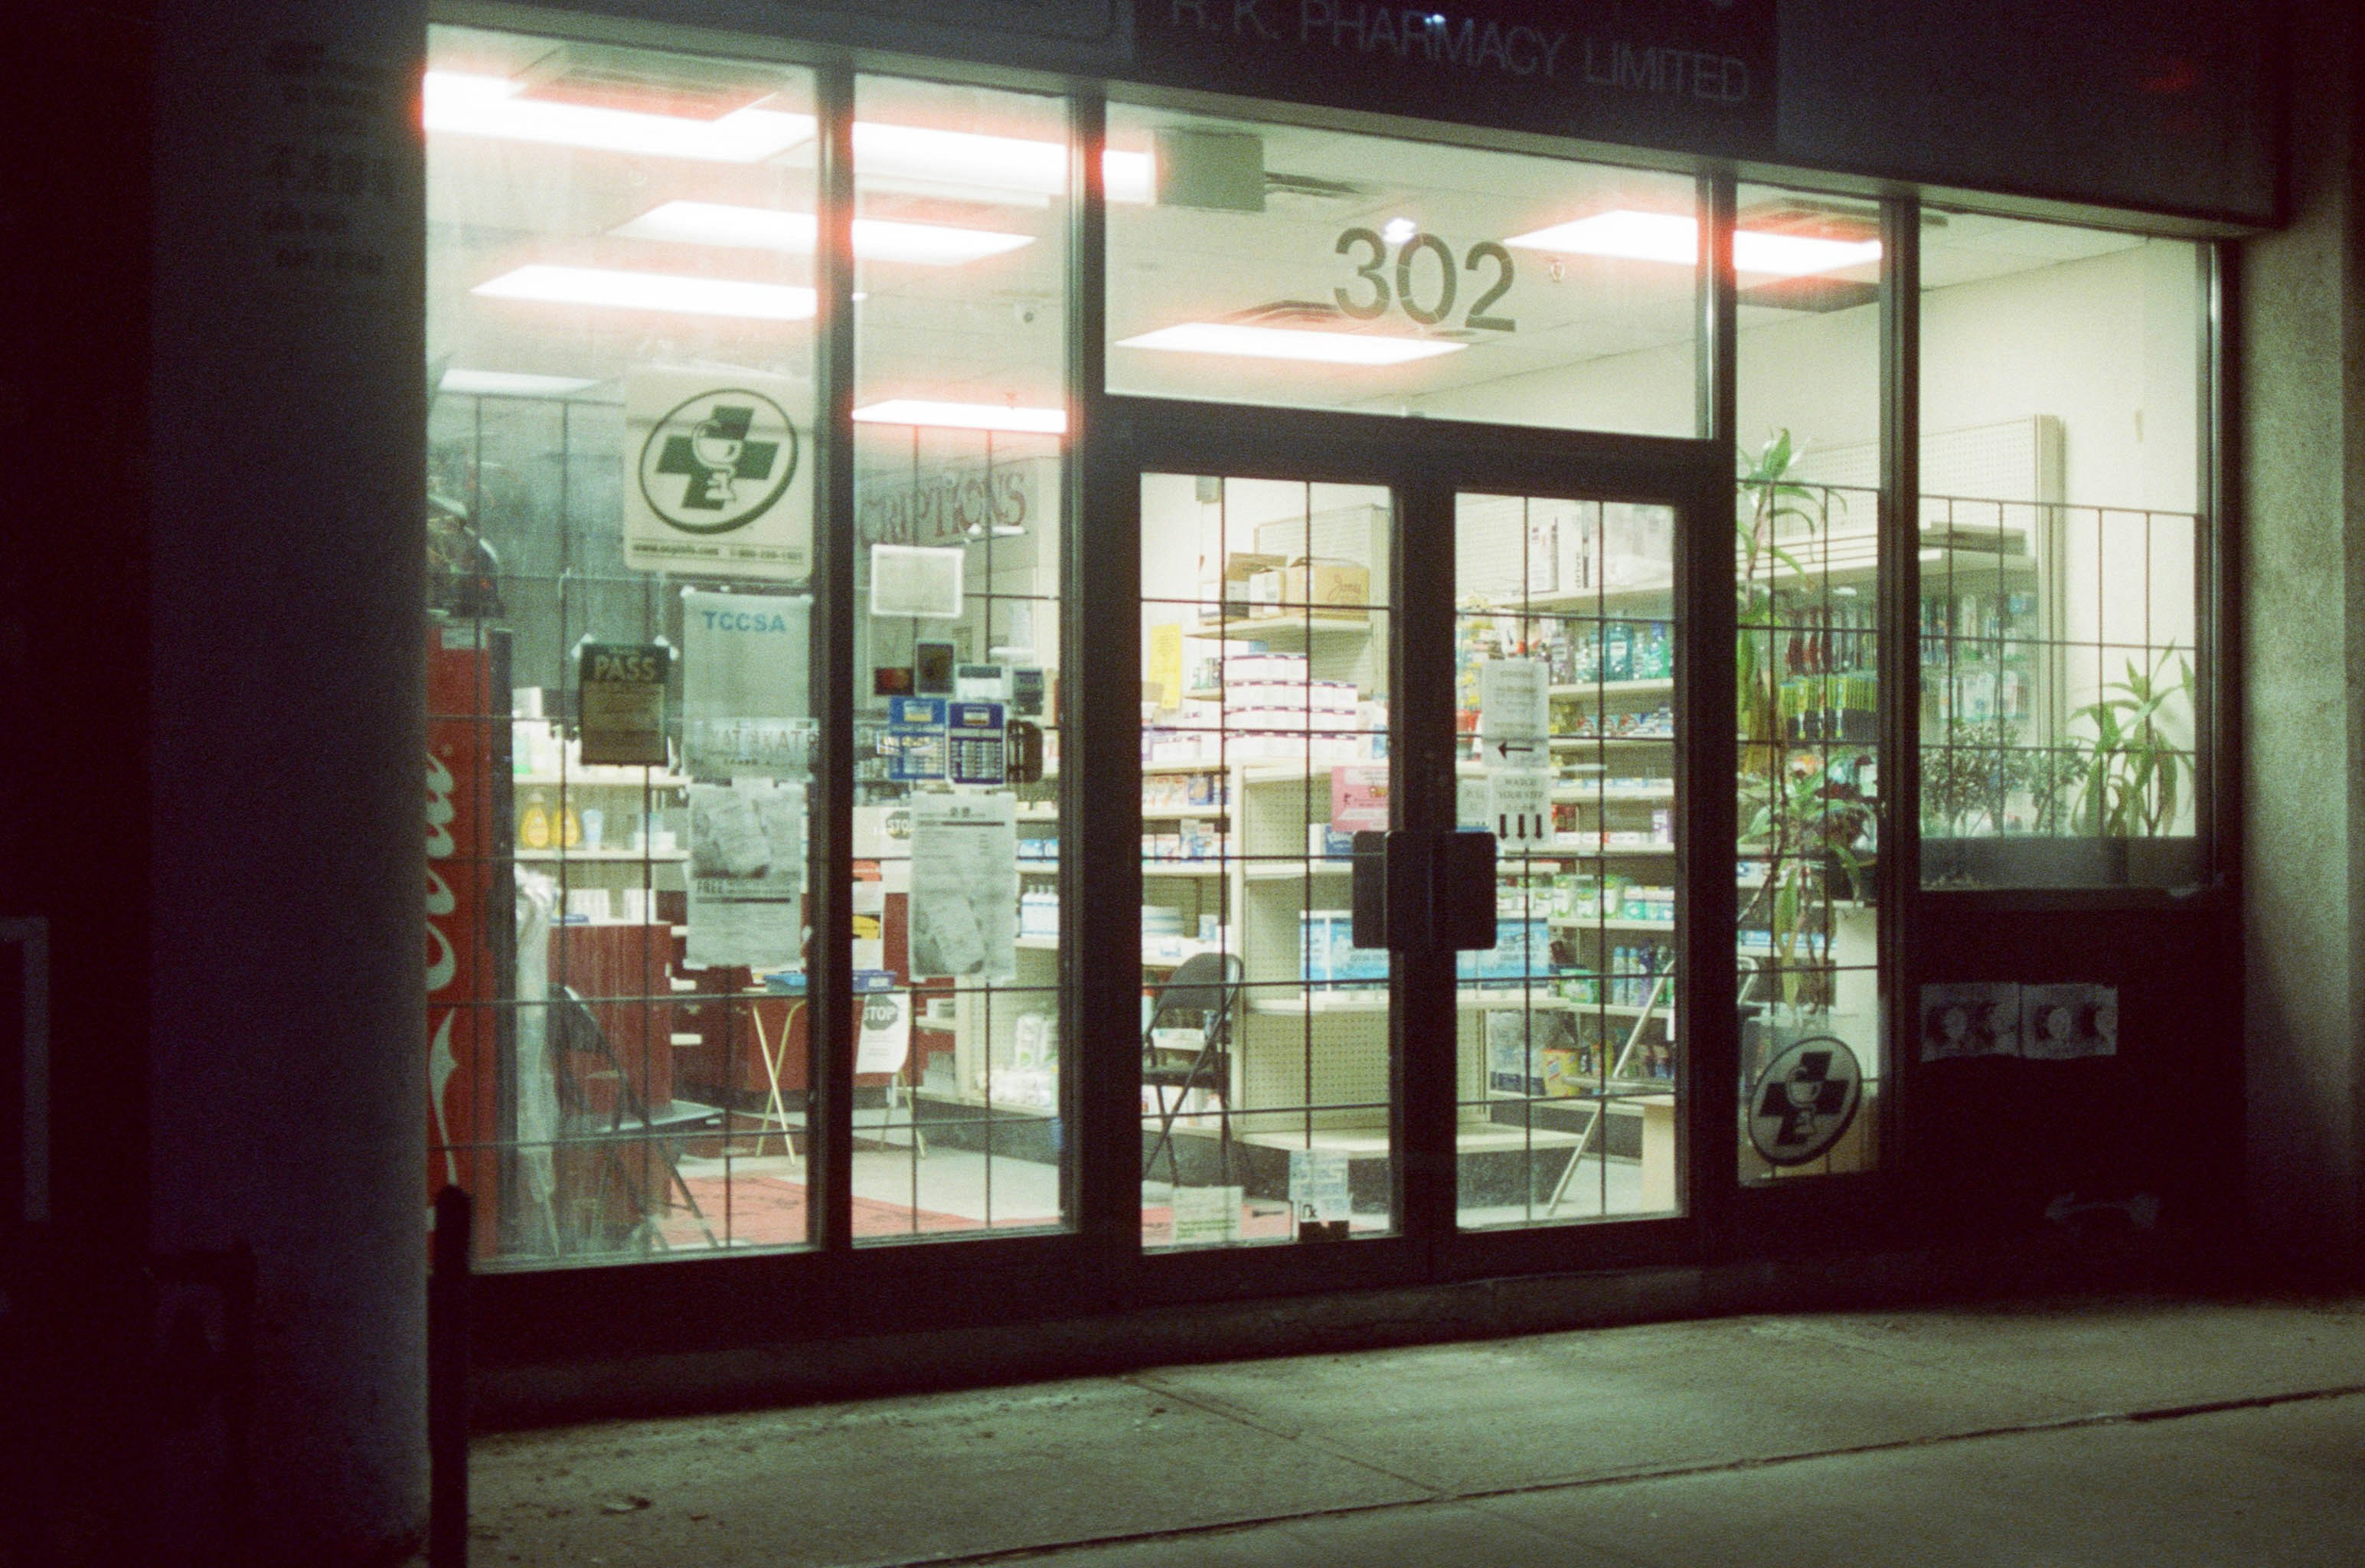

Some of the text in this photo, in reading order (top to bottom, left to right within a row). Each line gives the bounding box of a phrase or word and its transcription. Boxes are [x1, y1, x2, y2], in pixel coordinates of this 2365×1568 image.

[1300, 4, 1567, 77] PHARMACY
[1583, 42, 1750, 103] LIMITED
[1334, 227, 1517, 332] 302
[704, 610, 787, 632] TCCSA
[594, 654, 656, 681] PASS
[886, 821, 912, 831] STO
[863, 1006, 897, 1021] STOP
